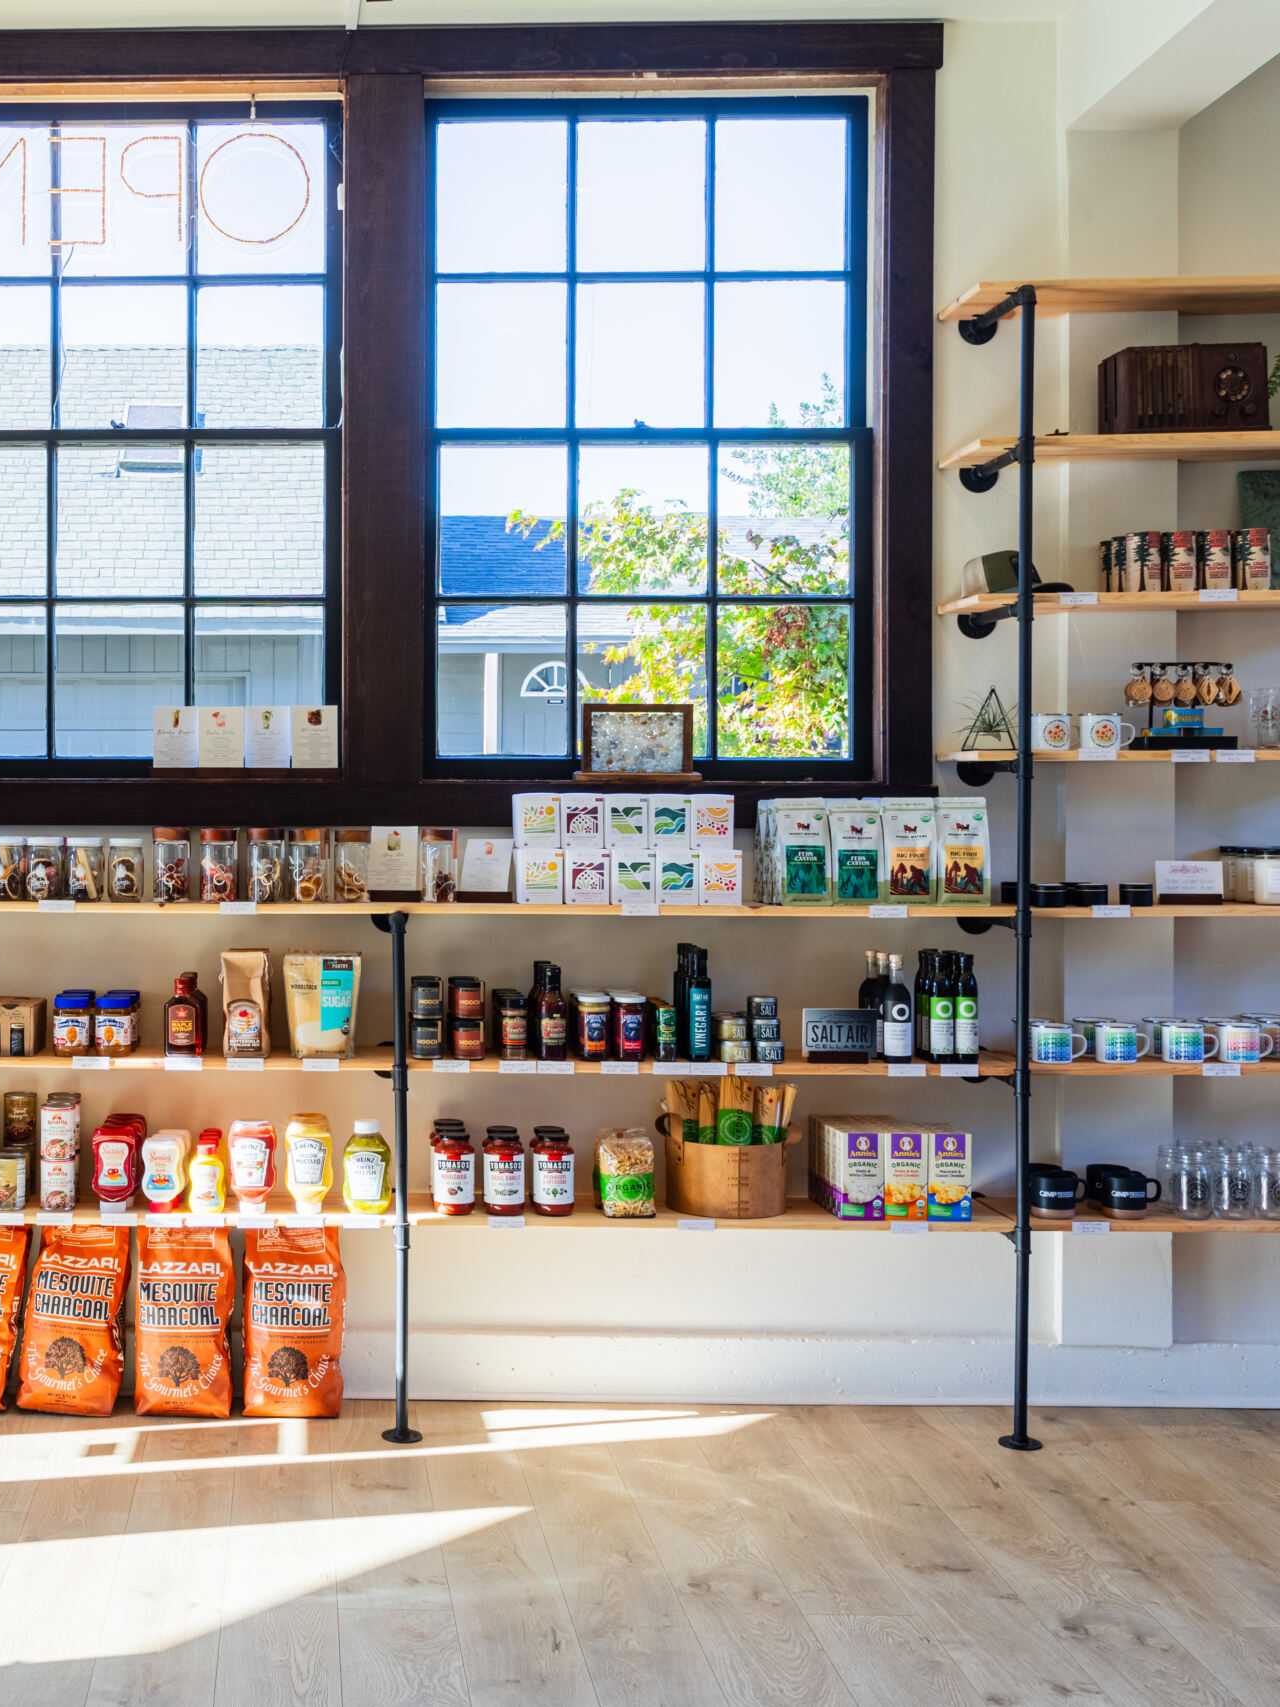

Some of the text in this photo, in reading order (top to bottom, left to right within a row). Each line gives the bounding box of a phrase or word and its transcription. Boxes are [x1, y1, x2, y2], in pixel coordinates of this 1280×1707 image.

[322, 995, 352, 1007] SUGAR
[760, 1005, 775, 1016] SALT
[695, 1009, 707, 1048] VINEGAR
[732, 1027, 746, 1038] SALT
[761, 1028, 777, 1038] SALT
[811, 1025, 869, 1043] SALT AIR
[733, 1049, 749, 1060] SALT
[765, 1049, 781, 1060] SALT
[850, 1150, 876, 1158] Annie's
[893, 1150, 920, 1158] Annie's
[937, 1150, 964, 1158] Annie's
[439, 1161, 470, 1169] TOMASOS
[490, 1162, 521, 1170] TOMASOS
[539, 1161, 570, 1169] TOMASOS
[935, 1161, 965, 1169] ORGANIC
[608, 1182, 651, 1191] ORGANIC
[40, 1251, 119, 1271] LAZZARI
[138, 1262, 221, 1276] LAZZARI
[249, 1262, 334, 1276] LAZZARI
[36, 1270, 115, 1298] MESQUITE
[138, 1281, 217, 1303] MESQUITE
[252, 1281, 332, 1303] MESQUITE
[34, 1293, 111, 1320] CHARCOAL
[138, 1305, 220, 1327] CHARCOAL
[251, 1303, 331, 1327] CHARCOAL
[26, 1341, 108, 1392] The Gourmet's Choice
[138, 1351, 223, 1400] The Gourmet's Choice
[250, 1351, 331, 1399] The Gourmet's Choice
